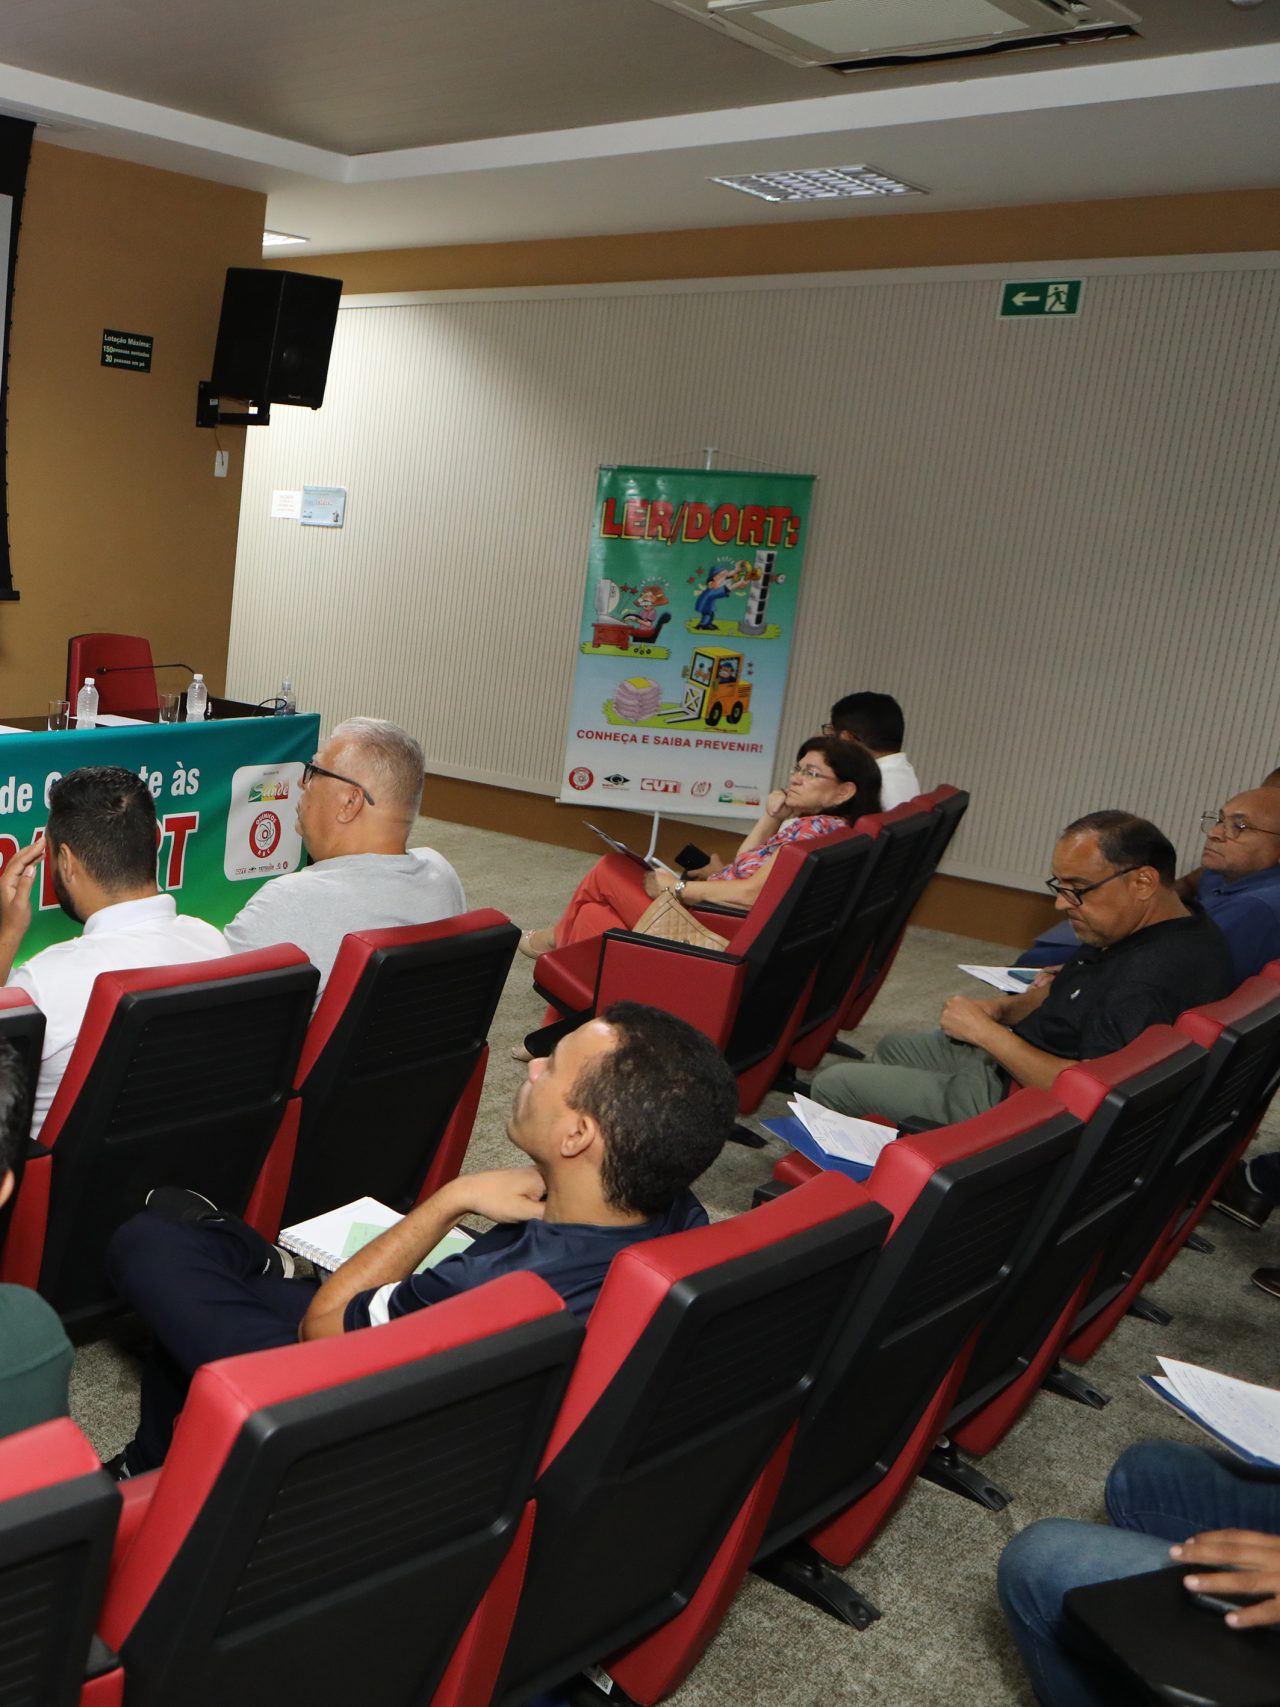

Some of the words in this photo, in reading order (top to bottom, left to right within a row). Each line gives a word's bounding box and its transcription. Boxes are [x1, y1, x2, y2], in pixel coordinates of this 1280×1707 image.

[599, 497, 801, 549] LER/DORT:
[576, 729, 638, 745] CONHEÇA
[641, 734, 649, 744] E
[653, 735, 691, 748] SAIBA
[695, 739, 764, 754] PREVENIR!
[170, 761, 200, 797] às
